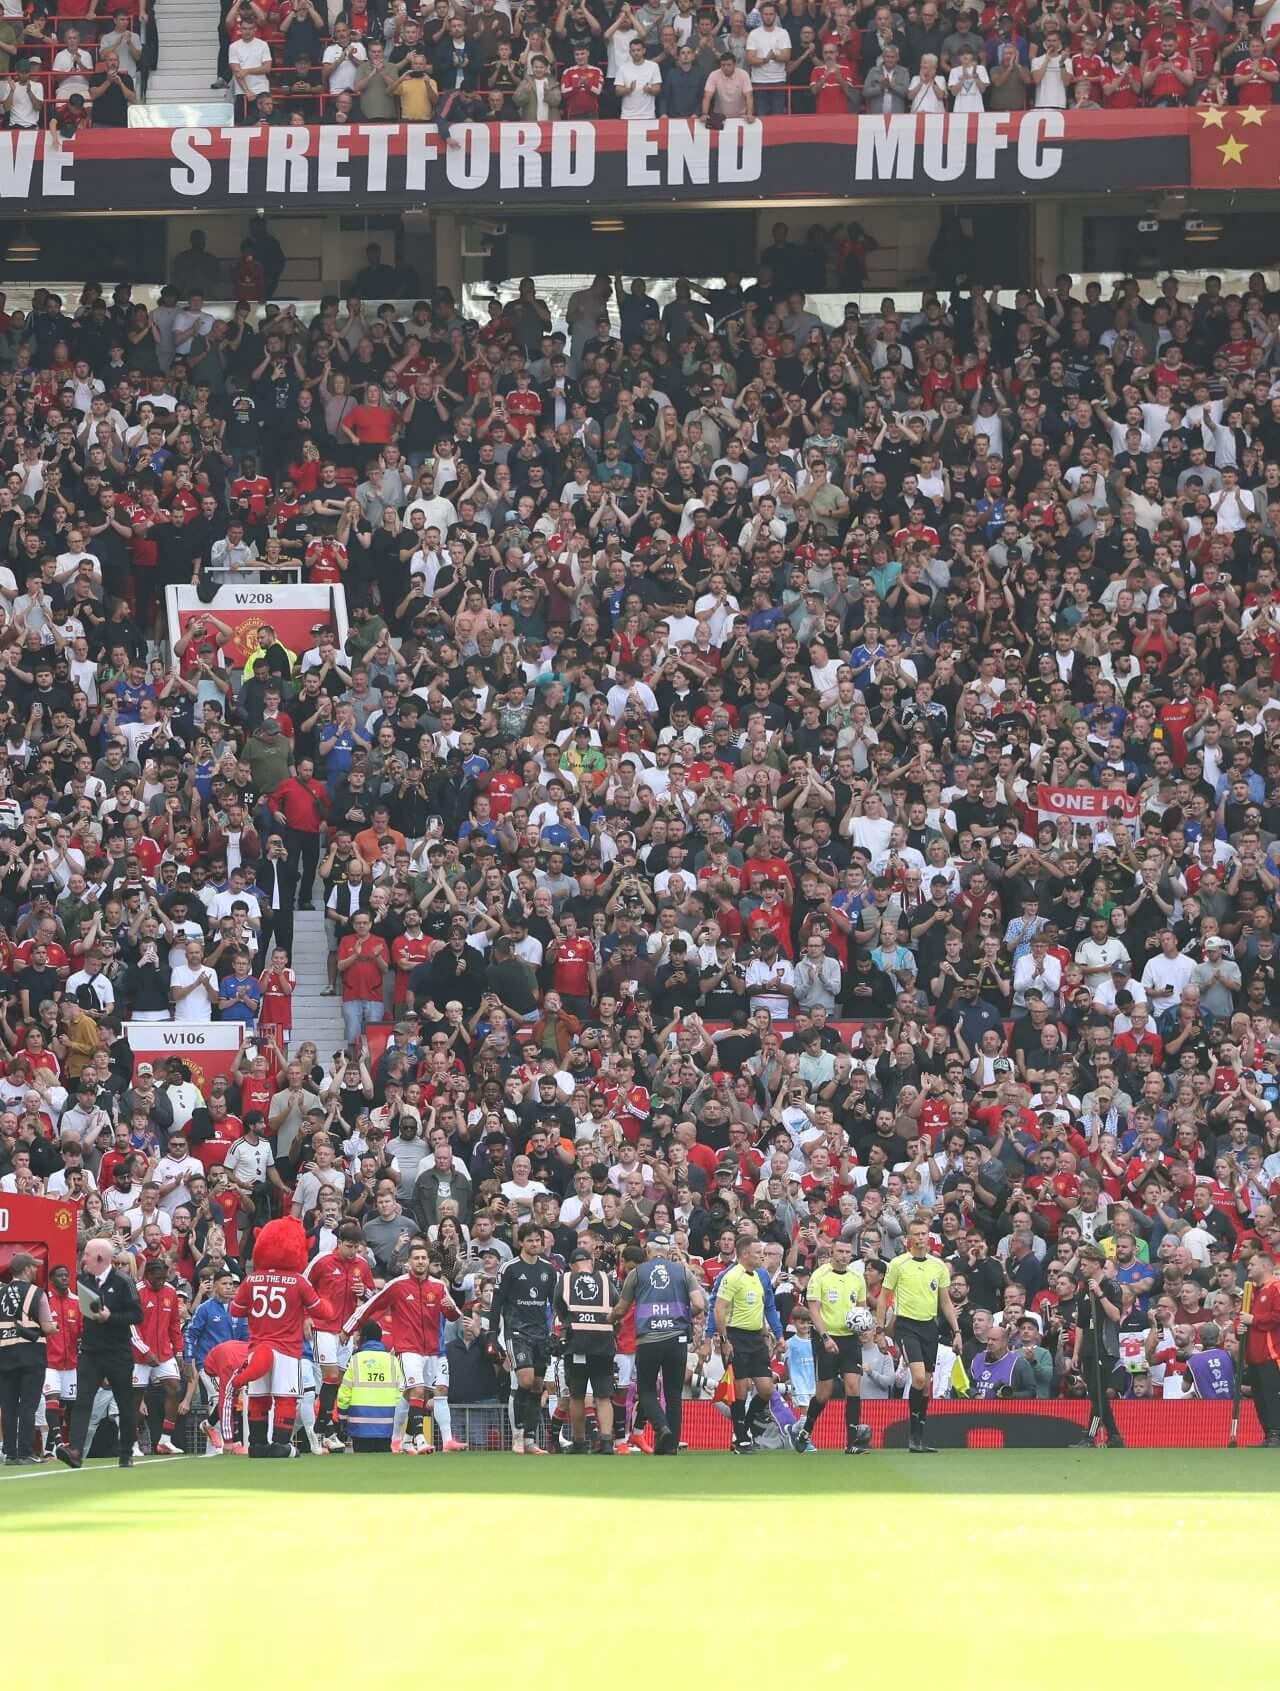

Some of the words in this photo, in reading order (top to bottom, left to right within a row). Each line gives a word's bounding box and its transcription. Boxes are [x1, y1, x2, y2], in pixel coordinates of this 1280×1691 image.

[855, 110, 1065, 181] MUFC
[170, 121, 595, 196] STRETFORD
[627, 117, 762, 187] END
[235, 592, 273, 604] W208
[1050, 792, 1095, 810] ONE
[1102, 796, 1136, 812] LOV
[163, 1032, 205, 1045] W106
[246, 1275, 264, 1284] FRED
[266, 1275, 280, 1283] THE
[281, 1276, 297, 1285] RED
[251, 1286, 287, 1319] 55
[652, 1304, 669, 1315] RH
[578, 1313, 596, 1322] 201
[651, 1319, 674, 1329] 5495
[367, 1372, 385, 1382] 376
